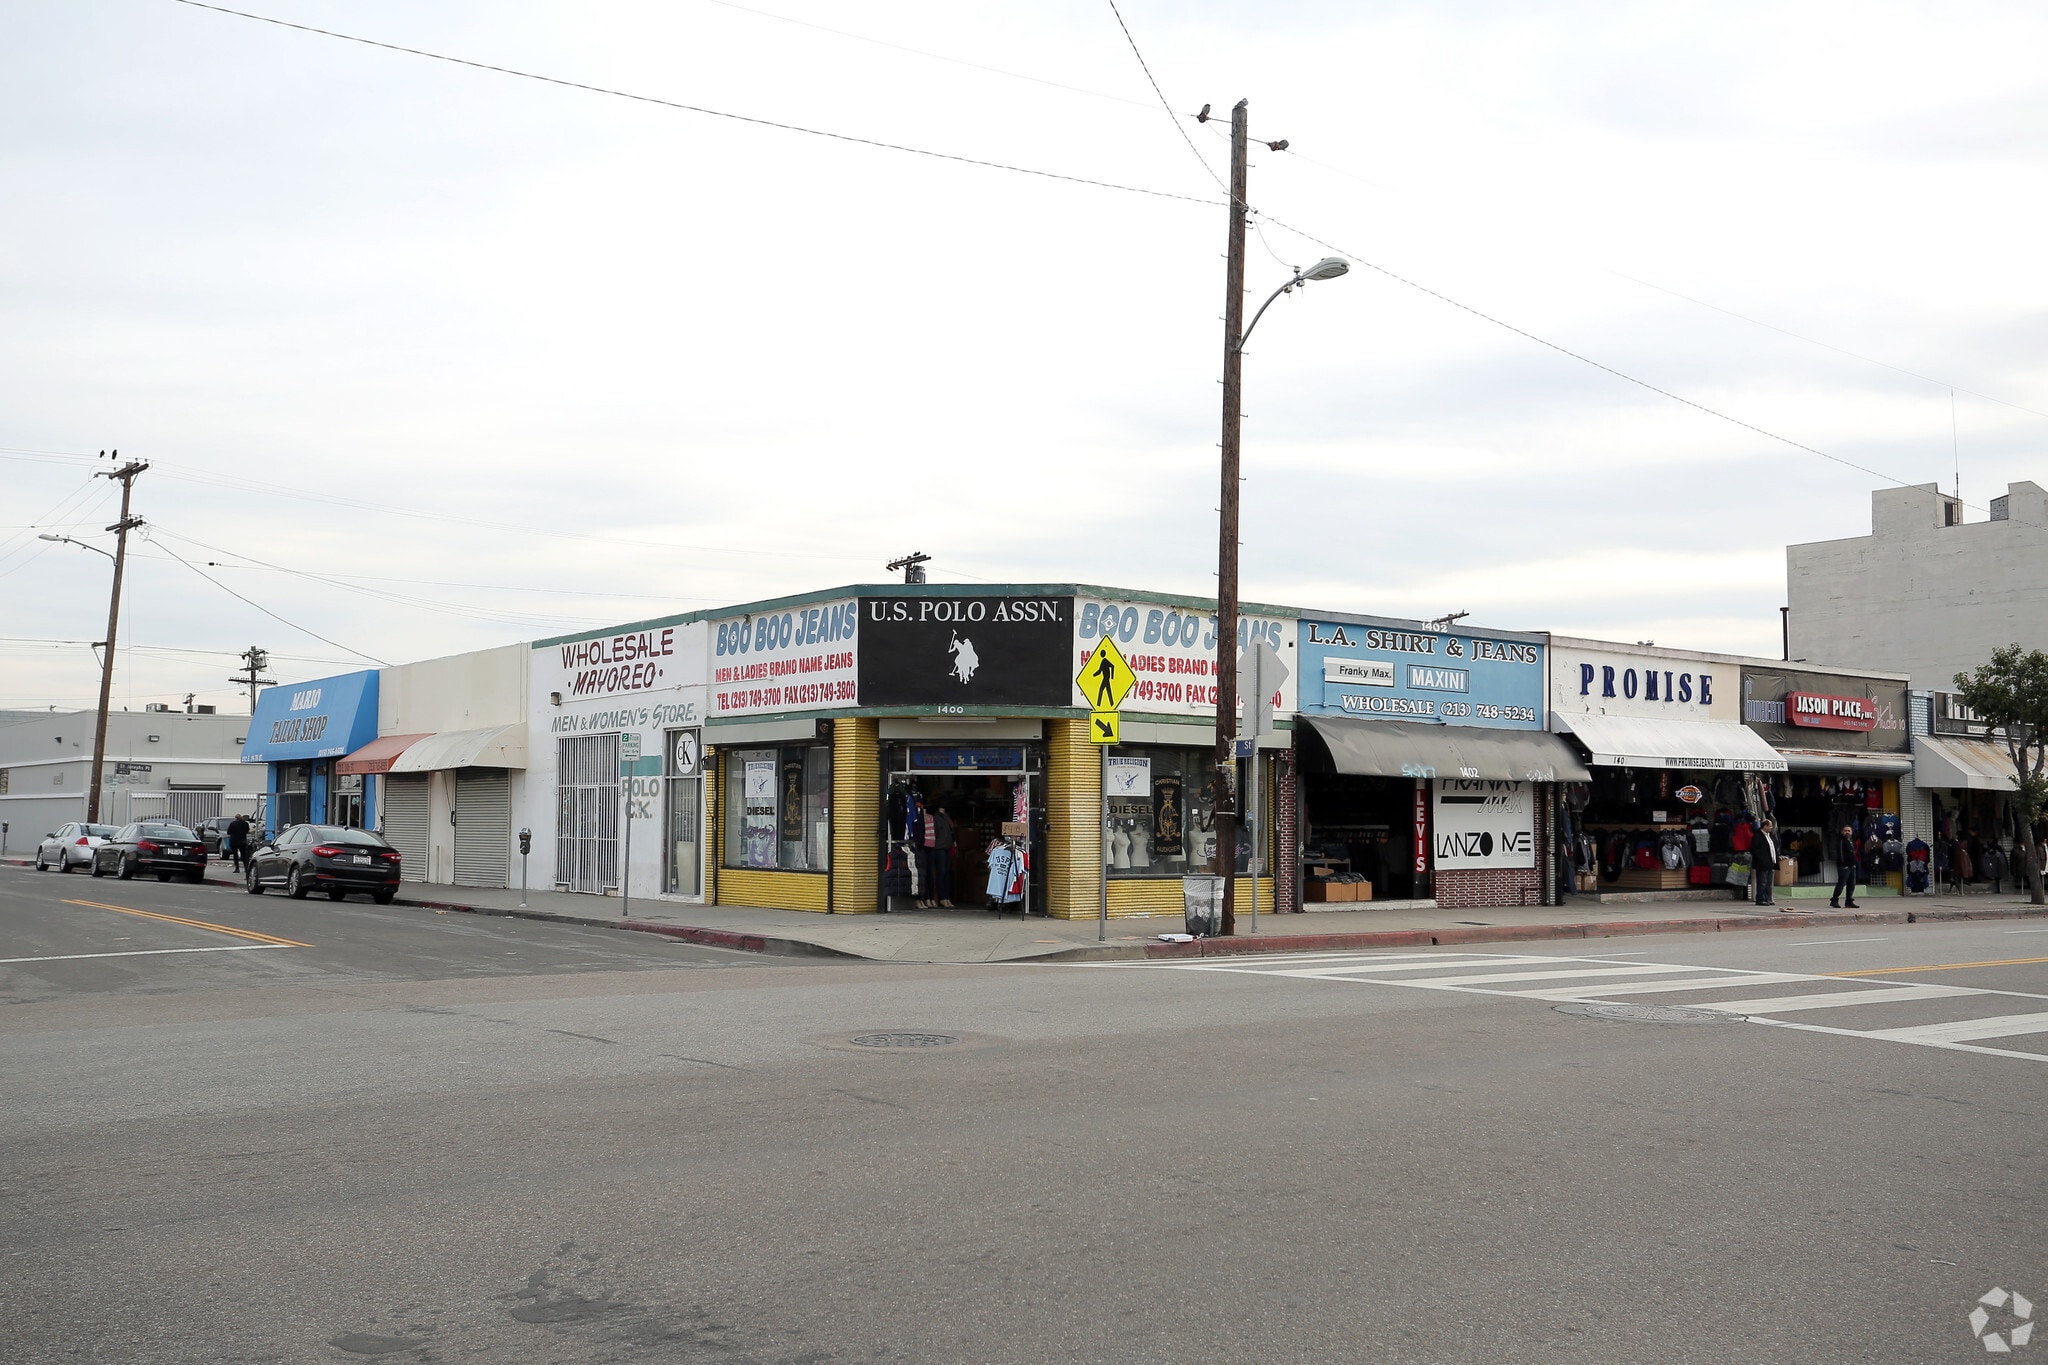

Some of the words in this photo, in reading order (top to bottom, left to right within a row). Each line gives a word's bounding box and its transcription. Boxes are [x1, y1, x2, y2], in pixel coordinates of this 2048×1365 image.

[870, 601, 913, 622] U.S.
[919, 601, 986, 622] POLO
[992, 601, 1063, 622] ASSN.
[716, 621, 752, 656] BOO
[754, 612, 793, 652] BOO
[795, 601, 857, 647] JEANS
[1079, 602, 1139, 643] BOO
[1143, 609, 1200, 648] BOO
[1421, 621, 1448, 633] 1402
[561, 628, 674, 670] WHOLESALE
[1308, 623, 1357, 647] L.A.
[1366, 629, 1437, 655] SHIRT
[1446, 637, 1463, 658] &
[1471, 640, 1538, 664] JEANS
[572, 661, 657, 696] MAYOREO
[715, 667, 732, 683] MEN
[733, 666, 740, 681] &
[741, 662, 768, 680] LADIES
[769, 658, 798, 677] BRAND
[799, 655, 823, 674] NAME
[824, 651, 853, 671] JEANS
[1168, 657, 1208, 677] BRAND
[1339, 665, 1369, 679] Franky
[1372, 668, 1392, 679] Max.
[1412, 668, 1464, 690] MAXINI
[1580, 663, 1713, 705] PROMISE
[289, 688, 322, 711] MARIO
[717, 693, 730, 711] TEL
[731, 690, 748, 709] (213)
[749, 687, 781, 707] 749-3700
[784, 685, 799, 704] FAX
[799, 683, 818, 704] (213)
[820, 680, 856, 702] 749-3800
[1186, 684, 1206, 704] FAX
[937, 706, 964, 714] 1400
[1341, 695, 1435, 715] WHOLESALE
[1440, 702, 1472, 717] (213)
[1476, 704, 1535, 722] 748-5234
[1797, 696, 1828, 715] JASON
[1832, 699, 1864, 720] PLACE,
[268, 717, 302, 745] TAILOR
[299, 715, 329, 742] SHOP
[551, 714, 579, 733] MEN
[580, 716, 589, 731] &
[588, 707, 648, 730] WOMEN'S
[1244, 741, 1252, 750] St
[1108, 758, 1123, 767] TRUE
[1123, 758, 1148, 767] RELIGION
[1459, 767, 1480, 779] 1402
[1665, 757, 1725, 768] WWW.PROMISEJEANS.COM
[1732, 760, 1750, 769] (213)
[1751, 761, 1785, 770] 749-7004
[622, 778, 660, 797] POLO
[747, 806, 775, 816] DIESEL
[1110, 805, 1153, 814] DIESEL
[1415, 790, 1426, 872] LEVIS
[1436, 831, 1494, 858] LANZO
